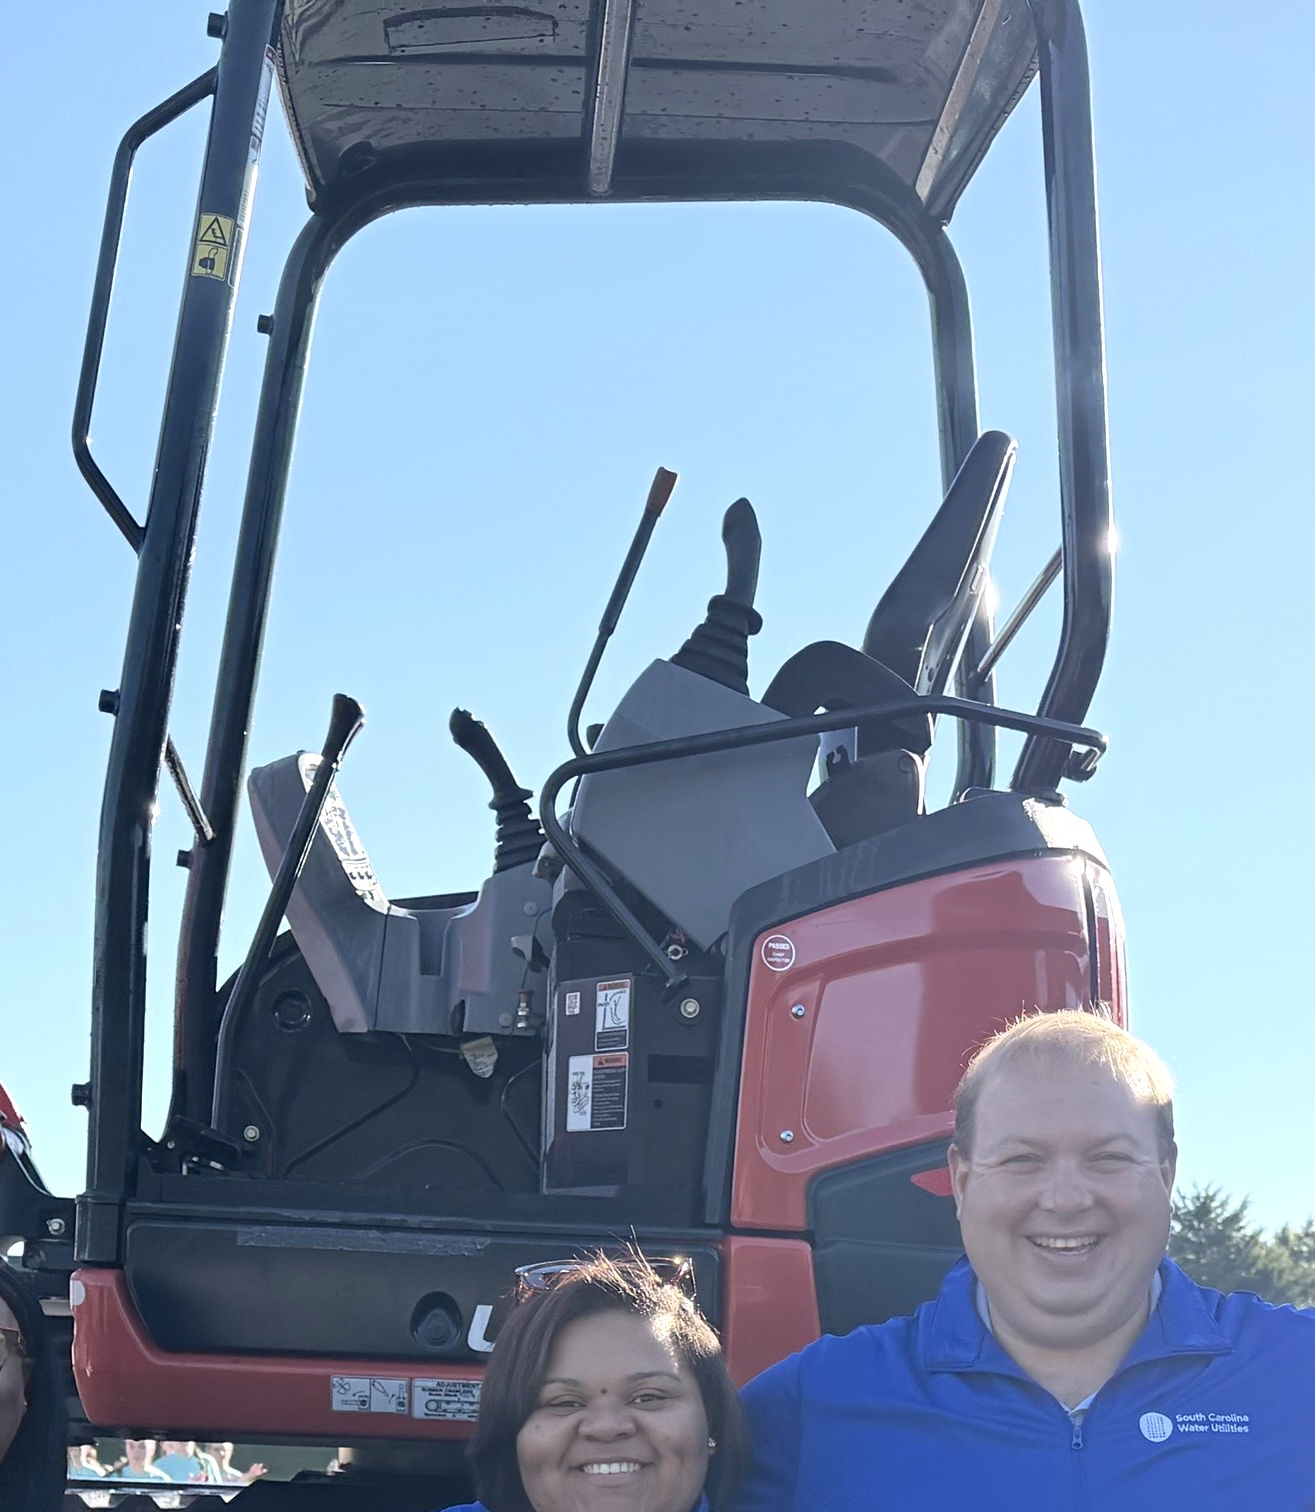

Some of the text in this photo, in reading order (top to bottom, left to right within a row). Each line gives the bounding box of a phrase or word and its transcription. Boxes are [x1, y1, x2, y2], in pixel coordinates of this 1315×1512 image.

[1175, 1412, 1249, 1423] South Carolina
[1177, 1423, 1249, 1433] Water Utilities
